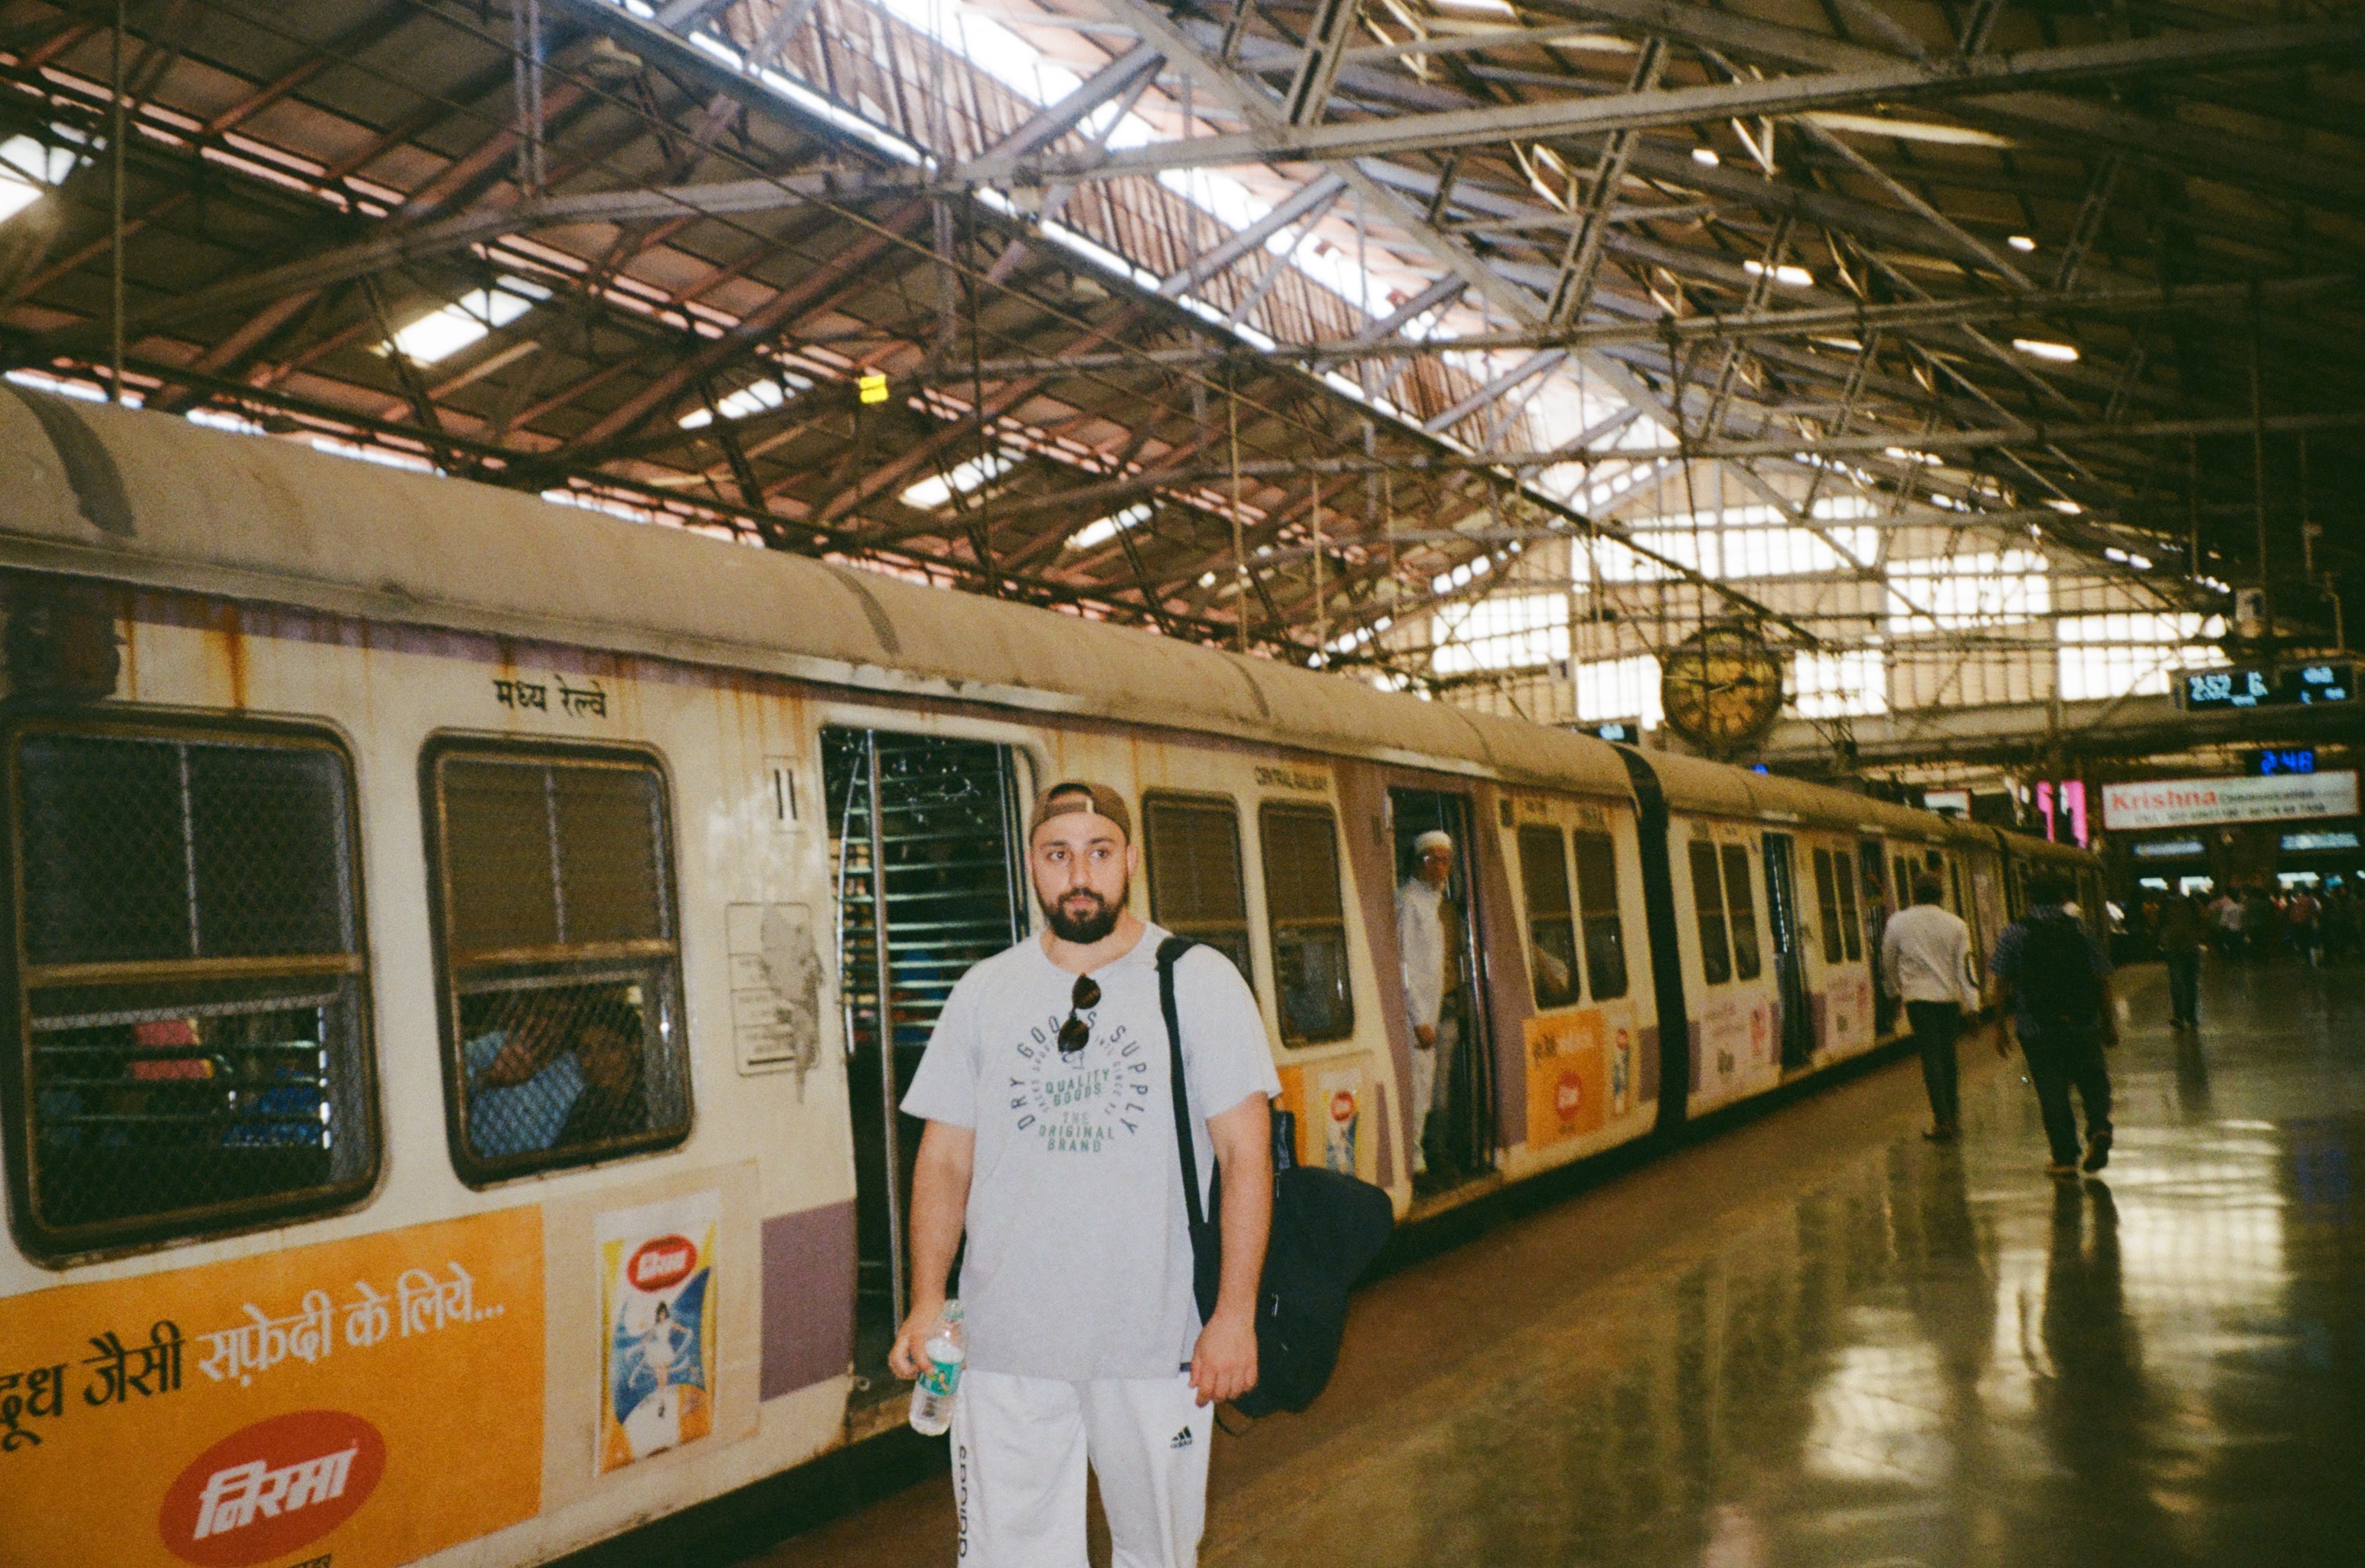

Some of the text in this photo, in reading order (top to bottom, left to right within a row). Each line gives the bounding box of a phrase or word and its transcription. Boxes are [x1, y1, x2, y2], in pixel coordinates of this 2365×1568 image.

[493, 672, 606, 718] मध्य रेल्वे
[2111, 789, 2218, 812] Krishna
[1009, 1011, 1148, 1135] DRY GOOS SUPPLY
[1045, 1069, 1109, 1094] QUALITY
[1053, 1082, 1101, 1106] GOODS
[1063, 1112, 1089, 1125] THE
[1039, 1125, 1114, 1140] ORIGINAL
[1047, 1138, 1101, 1152] BRAND
[80, 1320, 185, 1406] जैसी
[342, 1280, 390, 1348] के
[193, 1447, 358, 1540] निरमा
